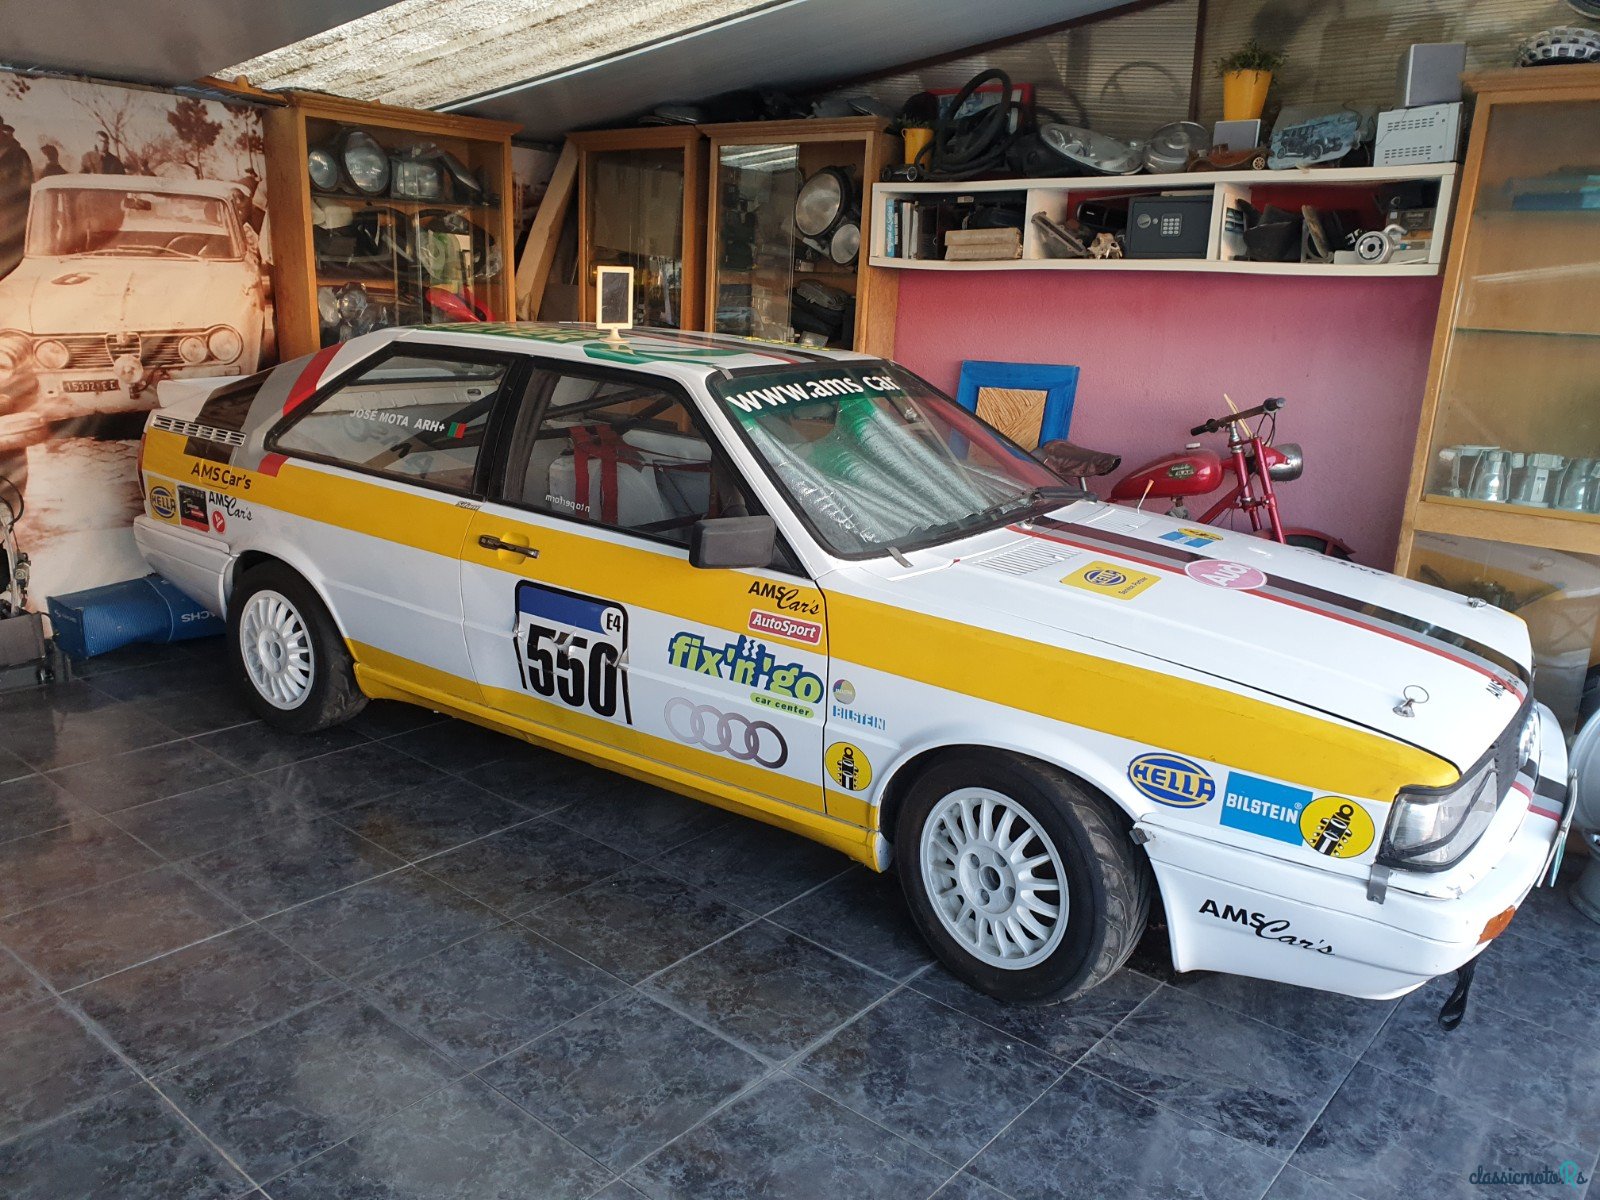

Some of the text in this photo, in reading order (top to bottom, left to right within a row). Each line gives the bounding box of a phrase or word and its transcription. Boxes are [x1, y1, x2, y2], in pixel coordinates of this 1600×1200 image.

[725, 376, 864, 413] www.ams
[380, 412, 409, 427] MOTA
[150, 495, 177, 511] HELLA
[1200, 562, 1252, 587] Audi
[606, 613, 621, 632] E4
[752, 614, 817, 639] AutoSport
[527, 623, 619, 717] 550
[755, 696, 811, 717] car center
[832, 705, 886, 731] BILSTEIN
[1132, 763, 1216, 803] HELLA
[1226, 791, 1300, 825] BILSTEIN
